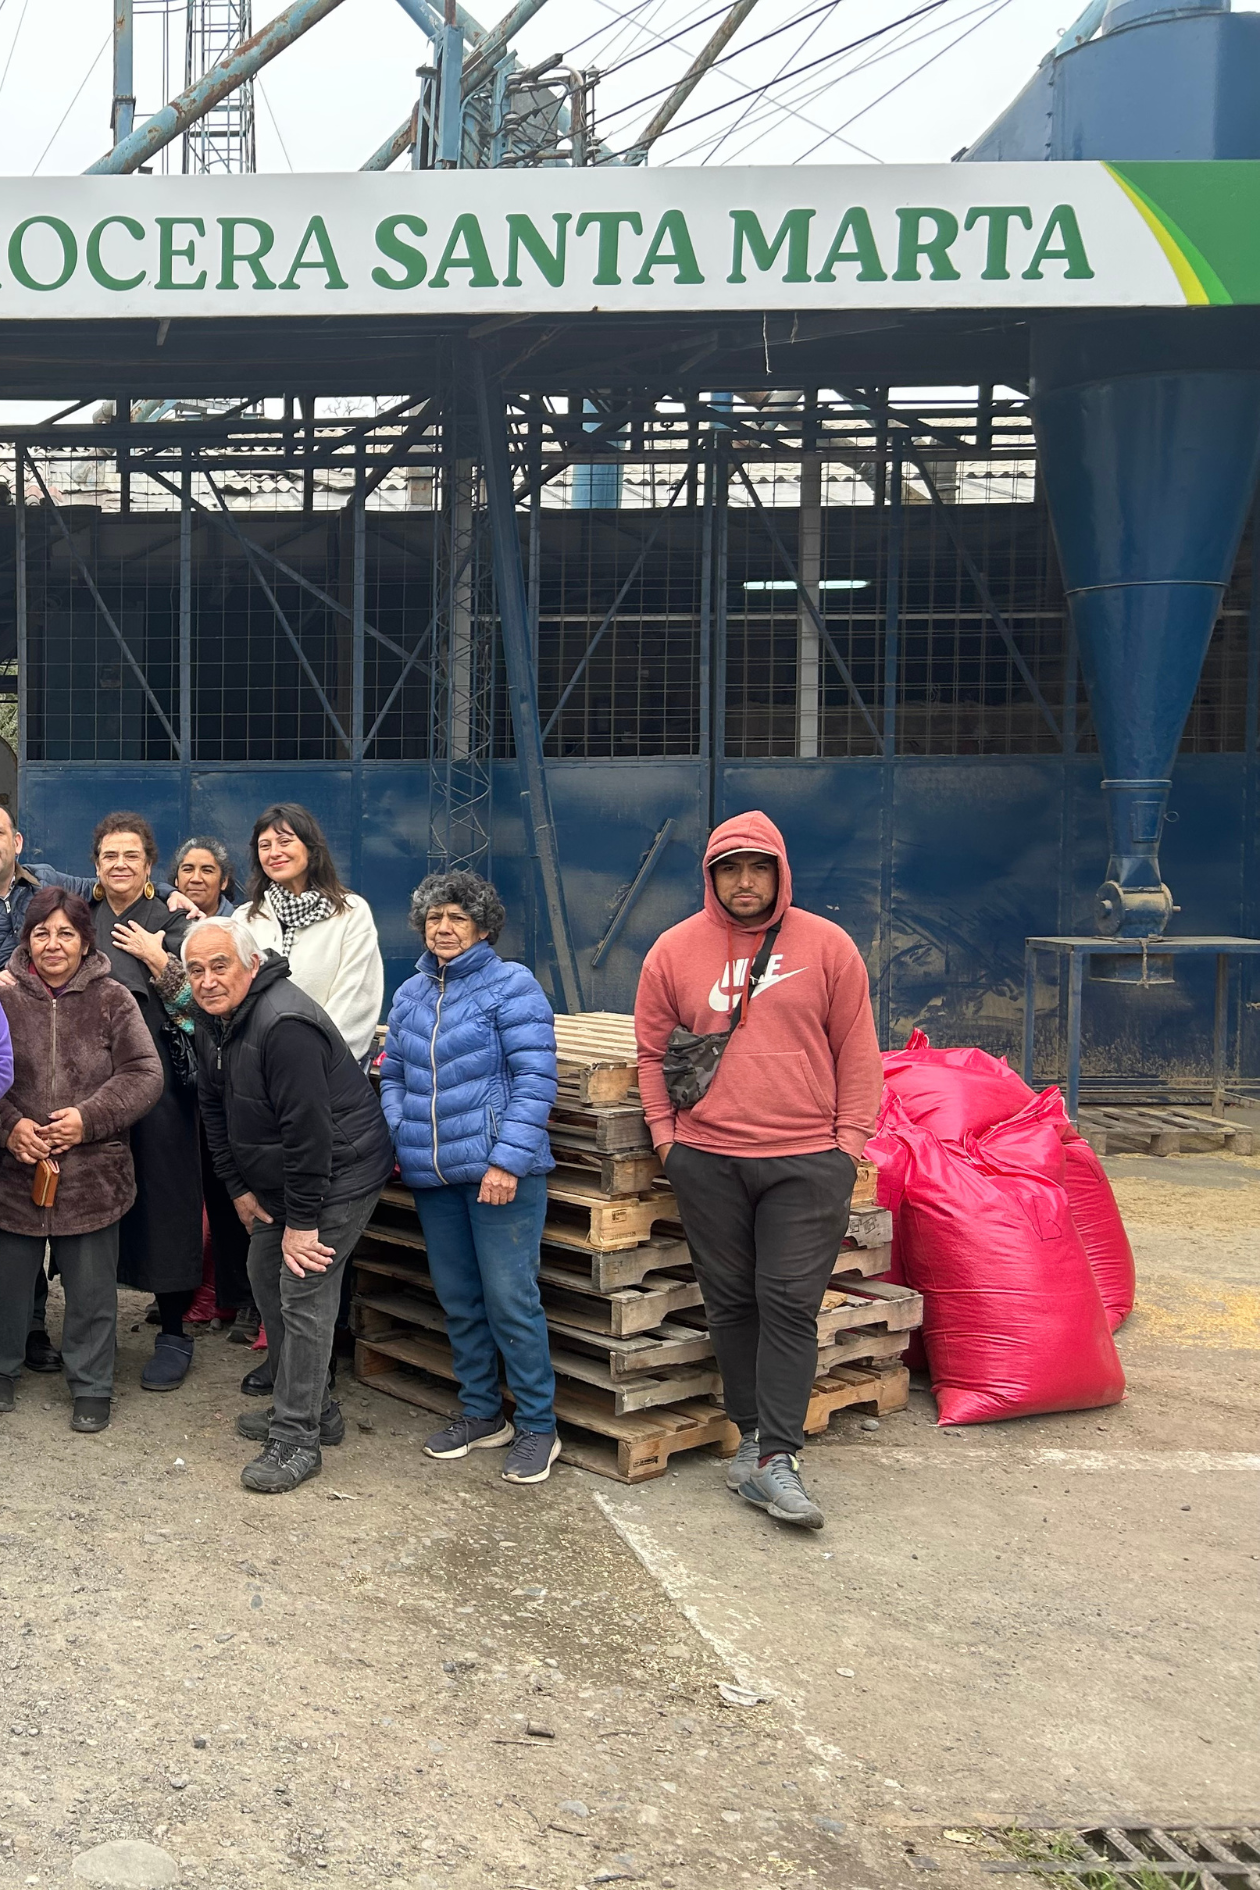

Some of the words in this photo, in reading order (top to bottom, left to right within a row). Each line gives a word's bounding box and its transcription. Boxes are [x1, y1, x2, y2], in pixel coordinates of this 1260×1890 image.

[372, 209, 703, 290] SANTA
[726, 204, 1095, 284] MARTA
[721, 954, 783, 988] NIE
